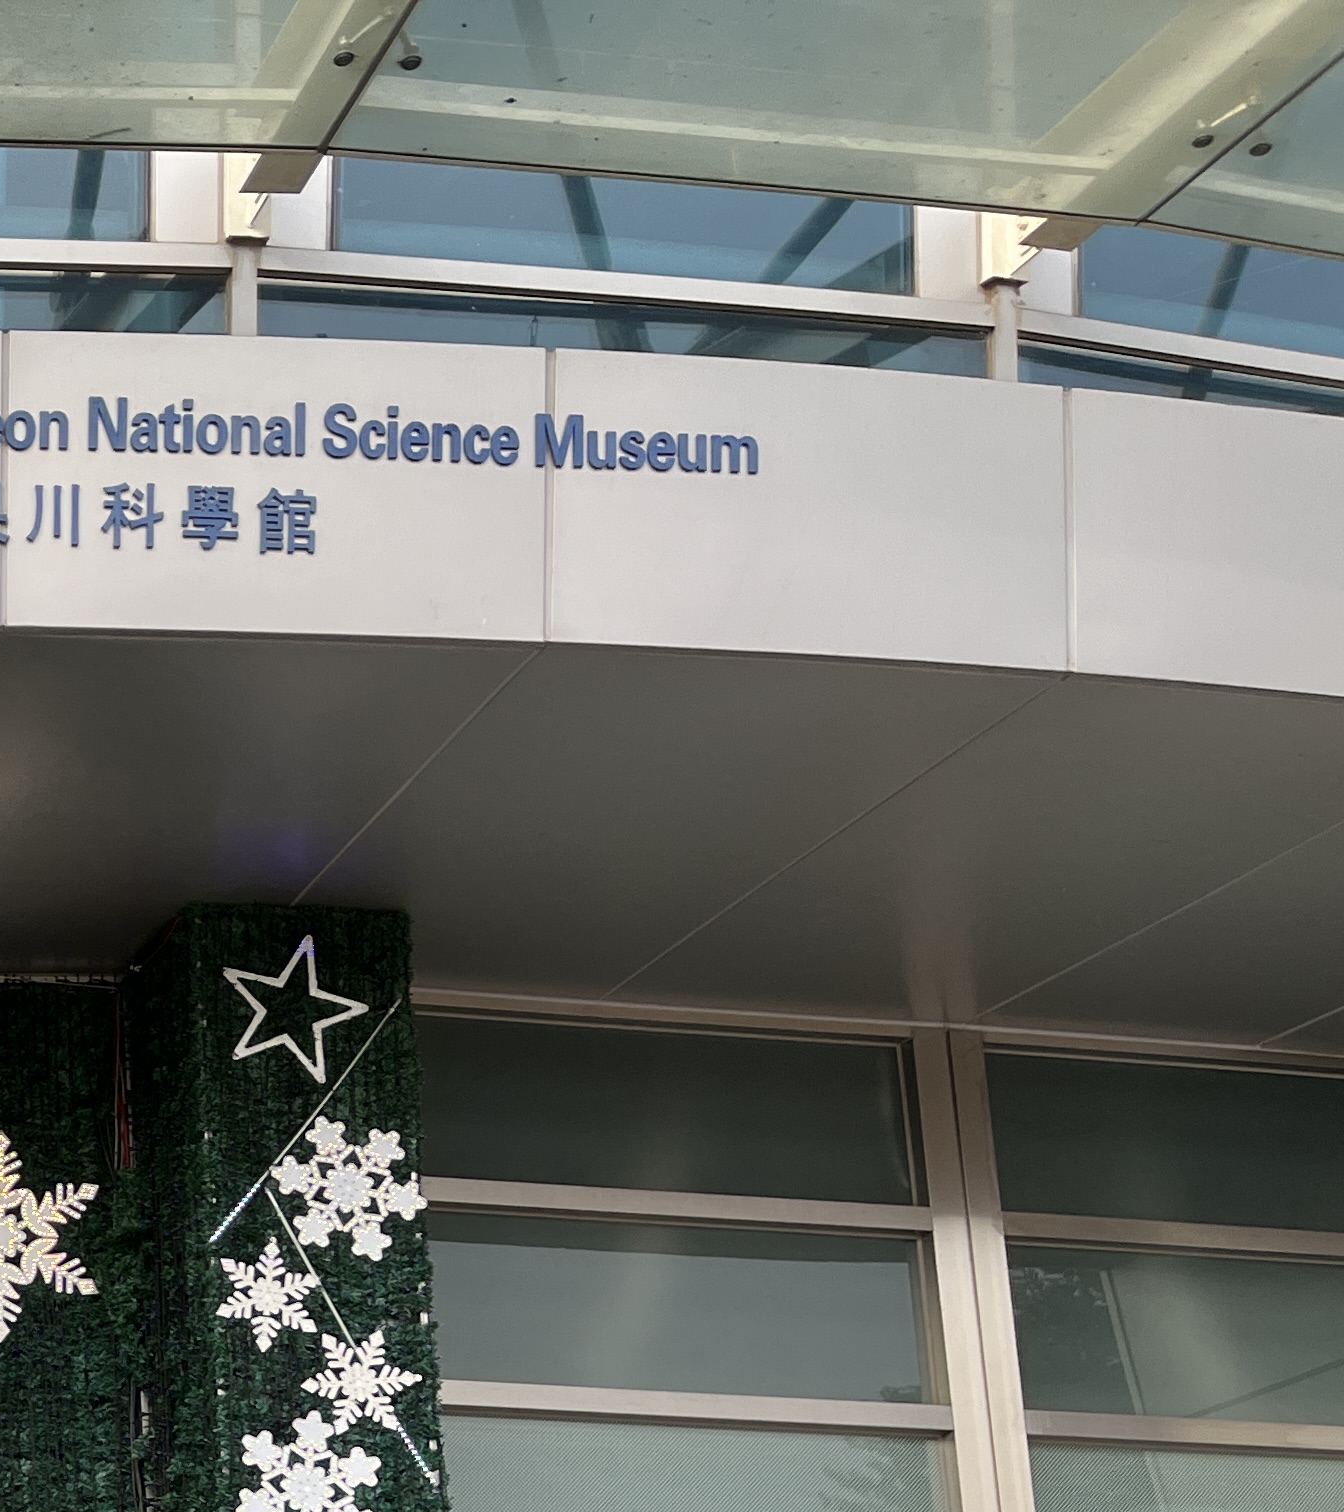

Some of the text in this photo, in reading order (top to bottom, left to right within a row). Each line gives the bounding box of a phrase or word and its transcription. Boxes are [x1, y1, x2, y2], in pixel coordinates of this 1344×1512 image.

[87, 396, 307, 459] National
[321, 403, 520, 467] Science
[534, 412, 760, 476] Museum
